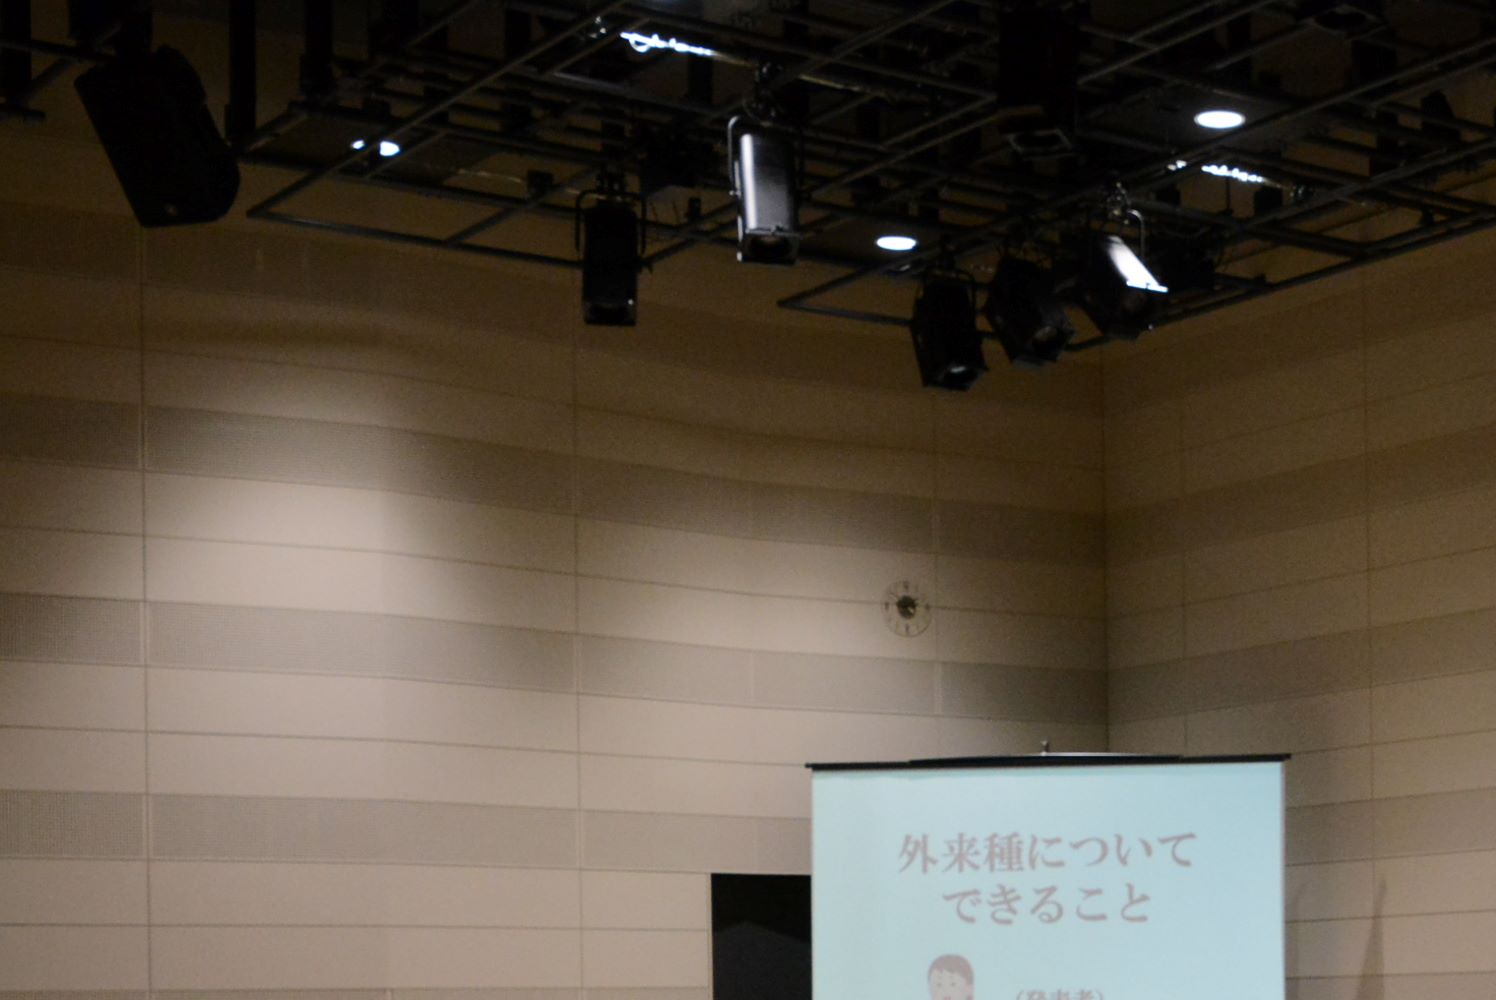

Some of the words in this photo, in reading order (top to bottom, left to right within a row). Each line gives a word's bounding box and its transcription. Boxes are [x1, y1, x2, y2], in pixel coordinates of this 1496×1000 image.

[898, 832, 1198, 874] 外来種について
[942, 882, 1153, 925] できること
